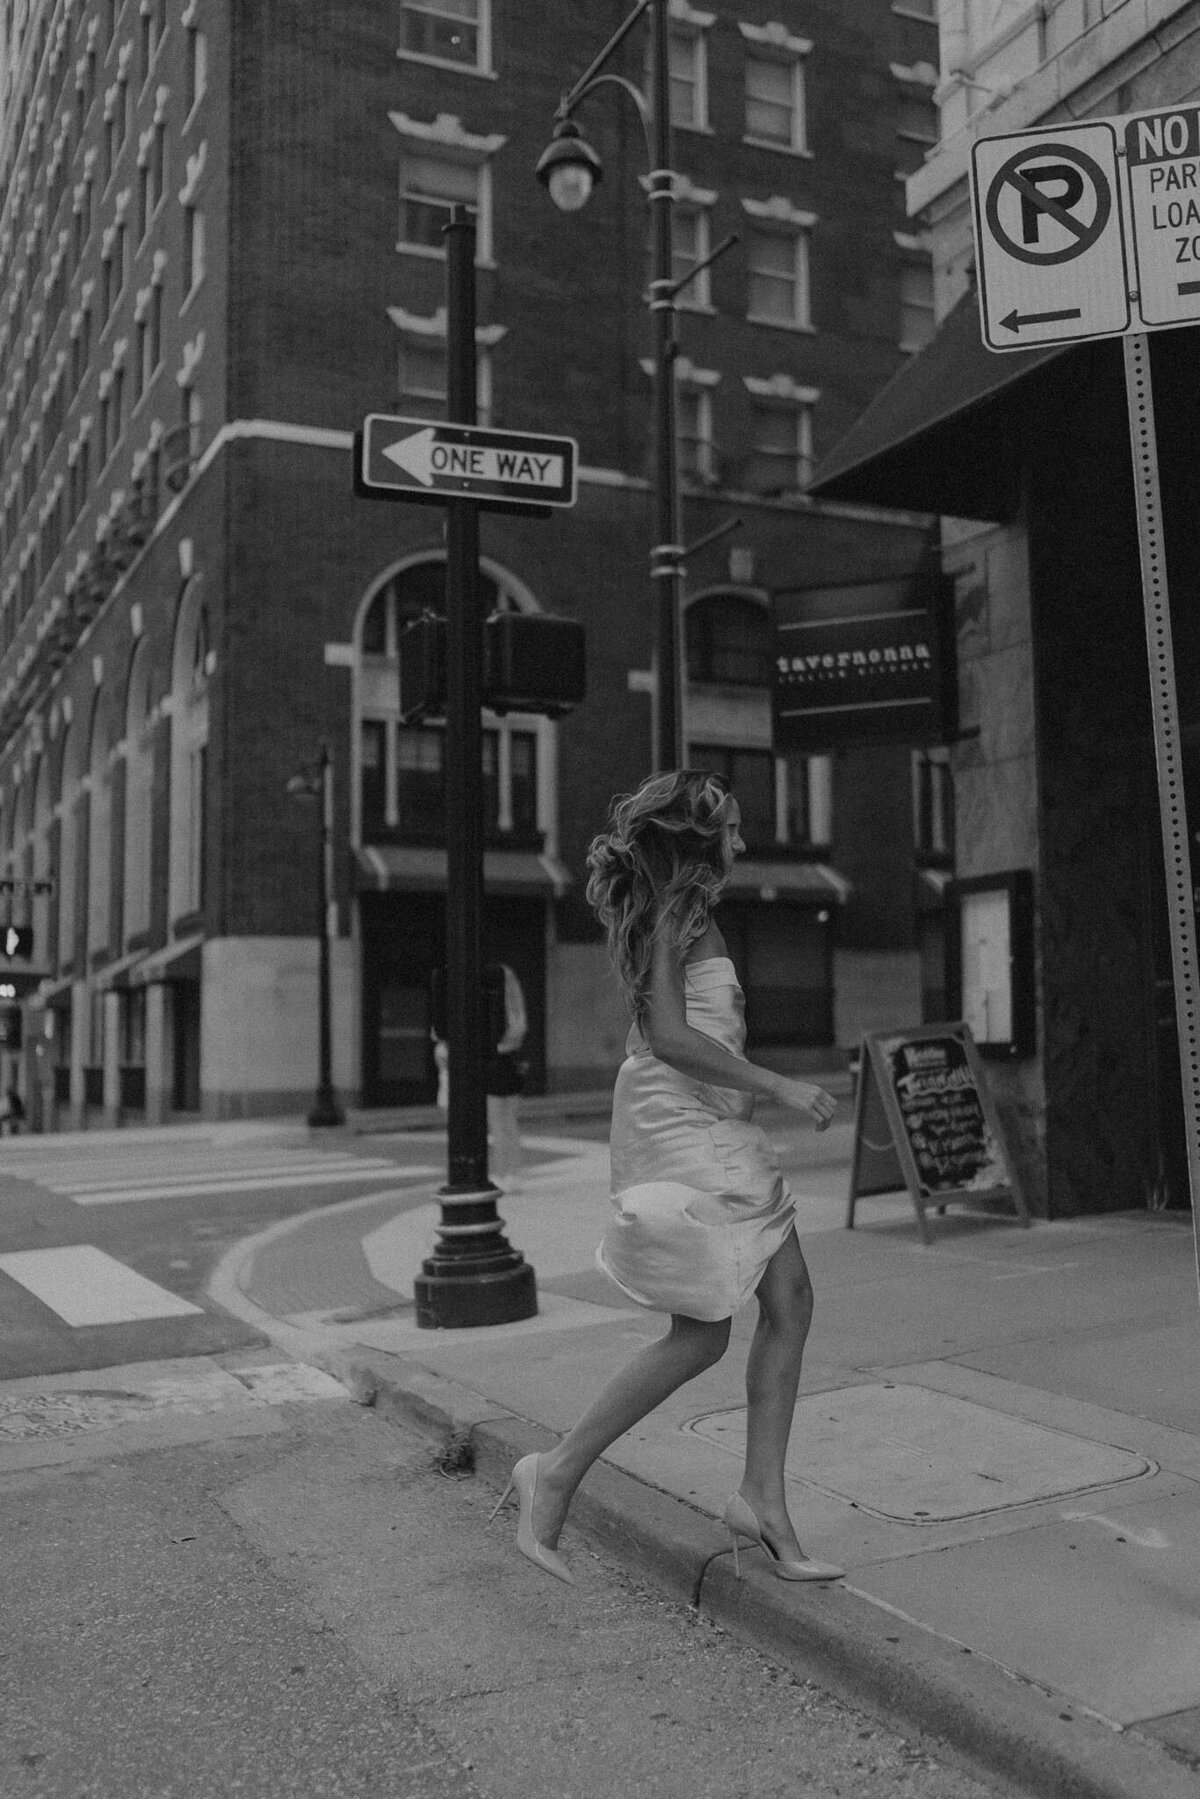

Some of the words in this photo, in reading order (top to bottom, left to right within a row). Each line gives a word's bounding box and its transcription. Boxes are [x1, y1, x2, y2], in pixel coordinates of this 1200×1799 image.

[1137, 115, 1189, 160] NO
[1149, 163, 1200, 193] PAR
[1152, 199, 1200, 230] LOA
[431, 446, 485, 475] ONE
[495, 452, 552, 481] WAY
[776, 643, 930, 674] tavernonna
